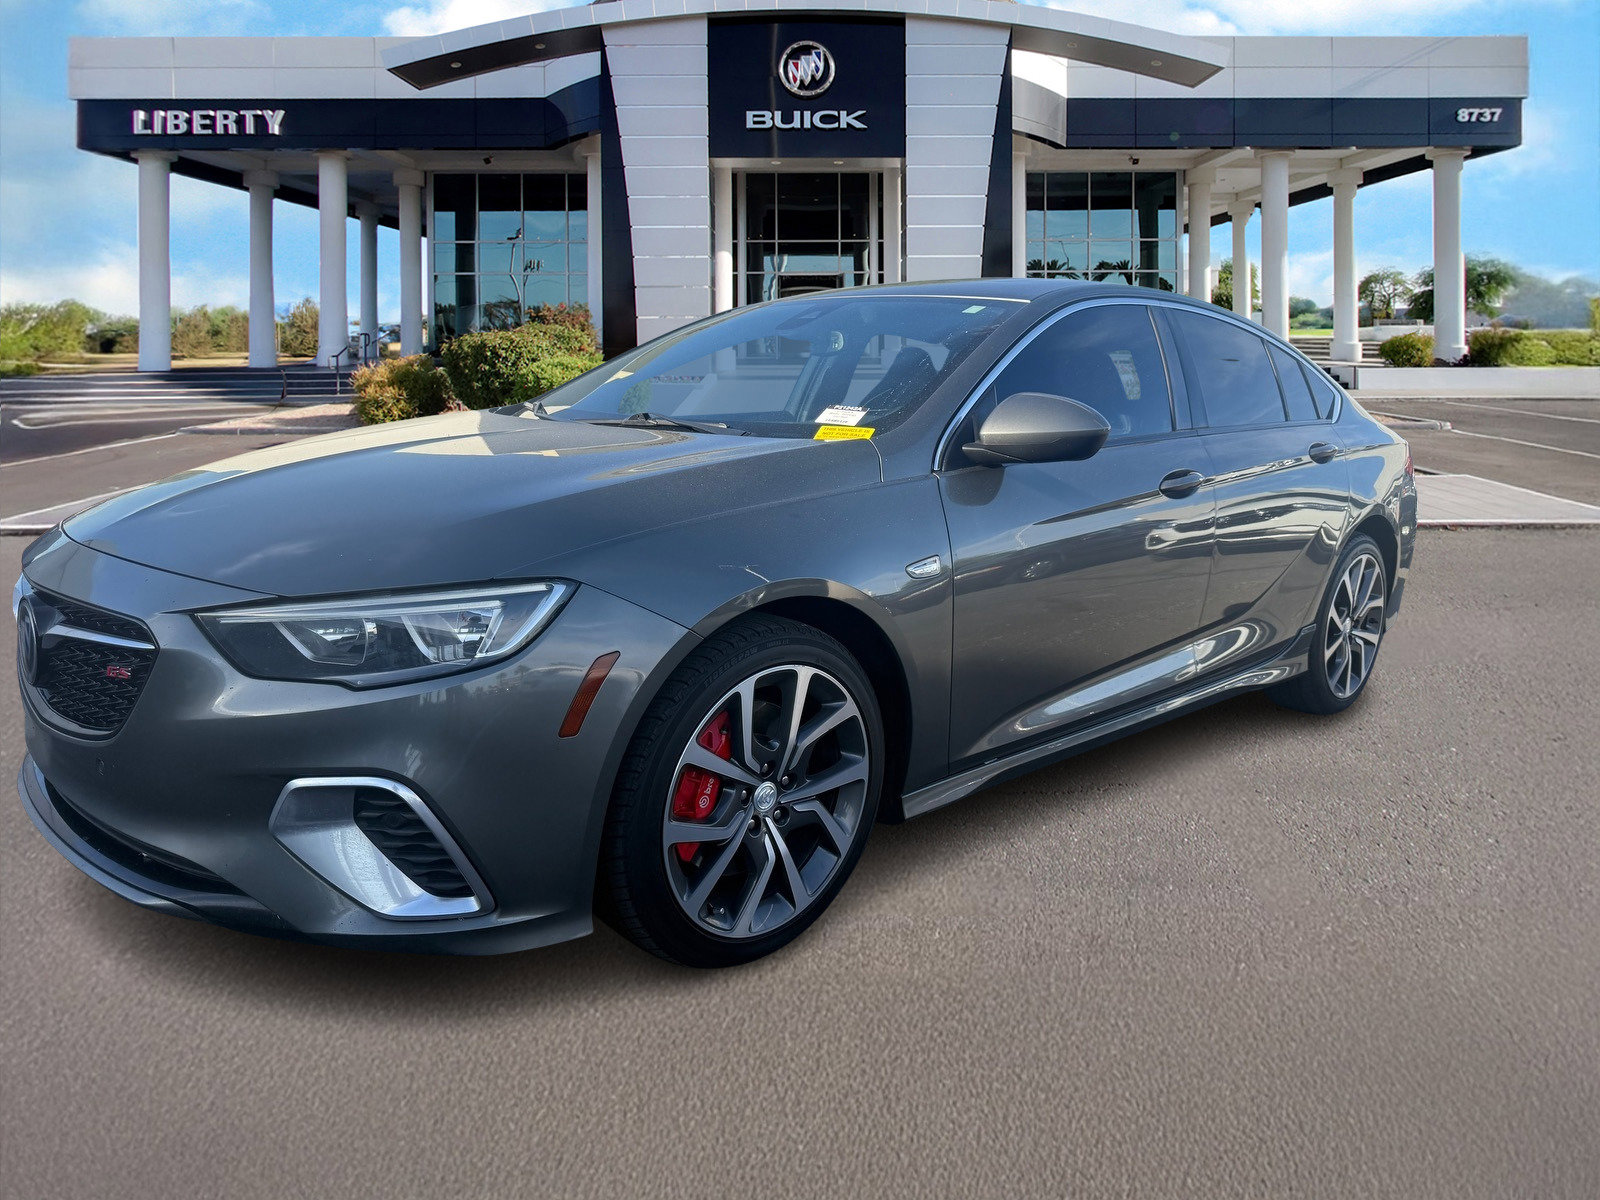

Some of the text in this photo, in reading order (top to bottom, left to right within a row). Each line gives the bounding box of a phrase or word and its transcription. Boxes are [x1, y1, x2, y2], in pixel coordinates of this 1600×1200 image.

[132, 109, 285, 135] LIBERTY
[746, 110, 868, 128] BUICK
[1456, 108, 1502, 122] 8737
[107, 665, 131, 679] GS
